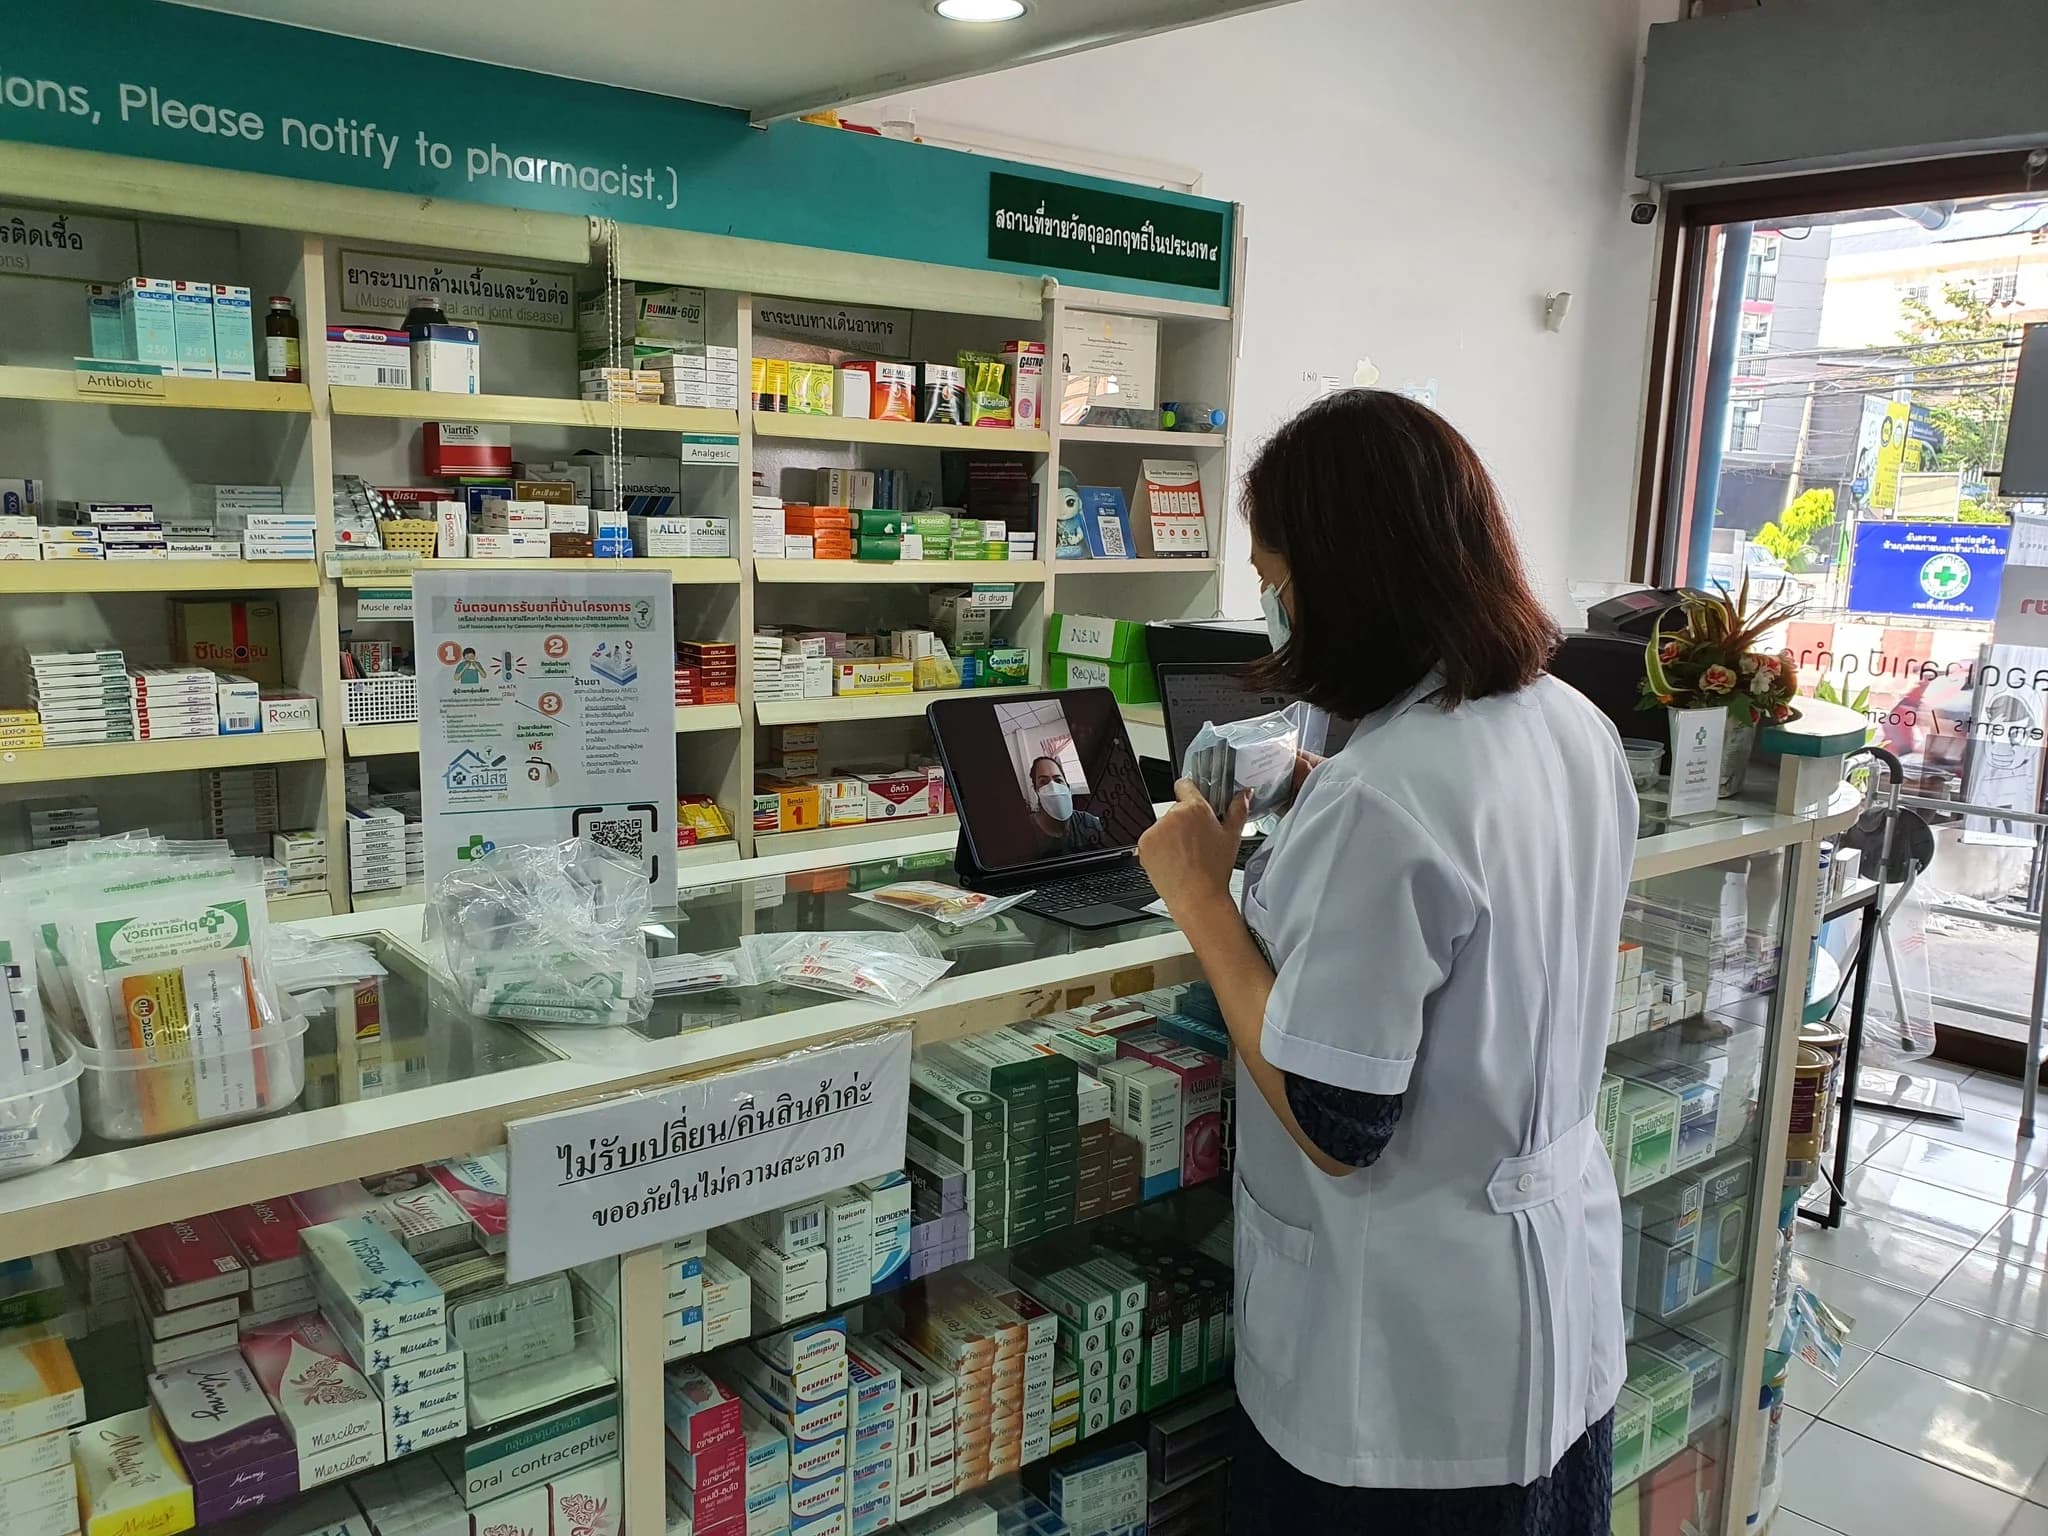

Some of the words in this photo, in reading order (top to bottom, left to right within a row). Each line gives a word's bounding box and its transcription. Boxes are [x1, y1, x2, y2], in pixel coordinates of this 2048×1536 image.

[119, 84, 264, 141] Please
[281, 115, 399, 170] notify
[414, 130, 453, 170] to
[467, 144, 678, 208] pharmacist.)
[347, 265, 569, 306] ยาระบบกล้ามเนื้อและข้อต่อ
[462, 304, 484, 318] and
[487, 306, 512, 322] joint
[516, 308, 565, 326] disease)
[646, 303, 700, 321] BUMAN-600
[760, 308, 894, 336] ยาระบบทางเดินอาหาร
[87, 374, 153, 391] Antibiotic
[1302, 371, 1318, 383] 180
[690, 448, 731, 460] Analgesic
[453, 597, 632, 614] ขั้นตอนการรับยาที่บ้านโครงการ
[978, 593, 986, 602] GI
[988, 593, 1008, 604] drugs
[361, 603, 390, 612] Muscle
[445, 645, 456, 661] 1
[549, 639, 564, 654] 2
[573, 676, 600, 687] ร้านยา
[858, 673, 891, 683] Nausil
[1072, 665, 1106, 685] Recycle
[544, 696, 559, 712] 3
[268, 707, 311, 724] Roxcin
[791, 806, 804, 825] 1
[556, 1071, 873, 1182] ไม่รับเปลี่ยน/คืนสินค้าค่ะ
[592, 1139, 845, 1228] ขออภัยในไม่ความสะดวก
[1027, 1351, 1048, 1364] Nora
[801, 1371, 843, 1394] DEXPENTEN
[1027, 1379, 1048, 1392] Nora
[800, 1410, 843, 1433] DEXPENTEN
[1026, 1407, 1046, 1421] Nora
[1024, 1435, 1044, 1449] Nora
[469, 1473, 503, 1494] Oral
[511, 1428, 616, 1479] contraceptive
[798, 1448, 840, 1472] DEXPENTEN
[229, 1469, 267, 1488] Minny
[229, 1492, 266, 1511] Minny
[797, 1486, 840, 1510] DEXPENTEN
